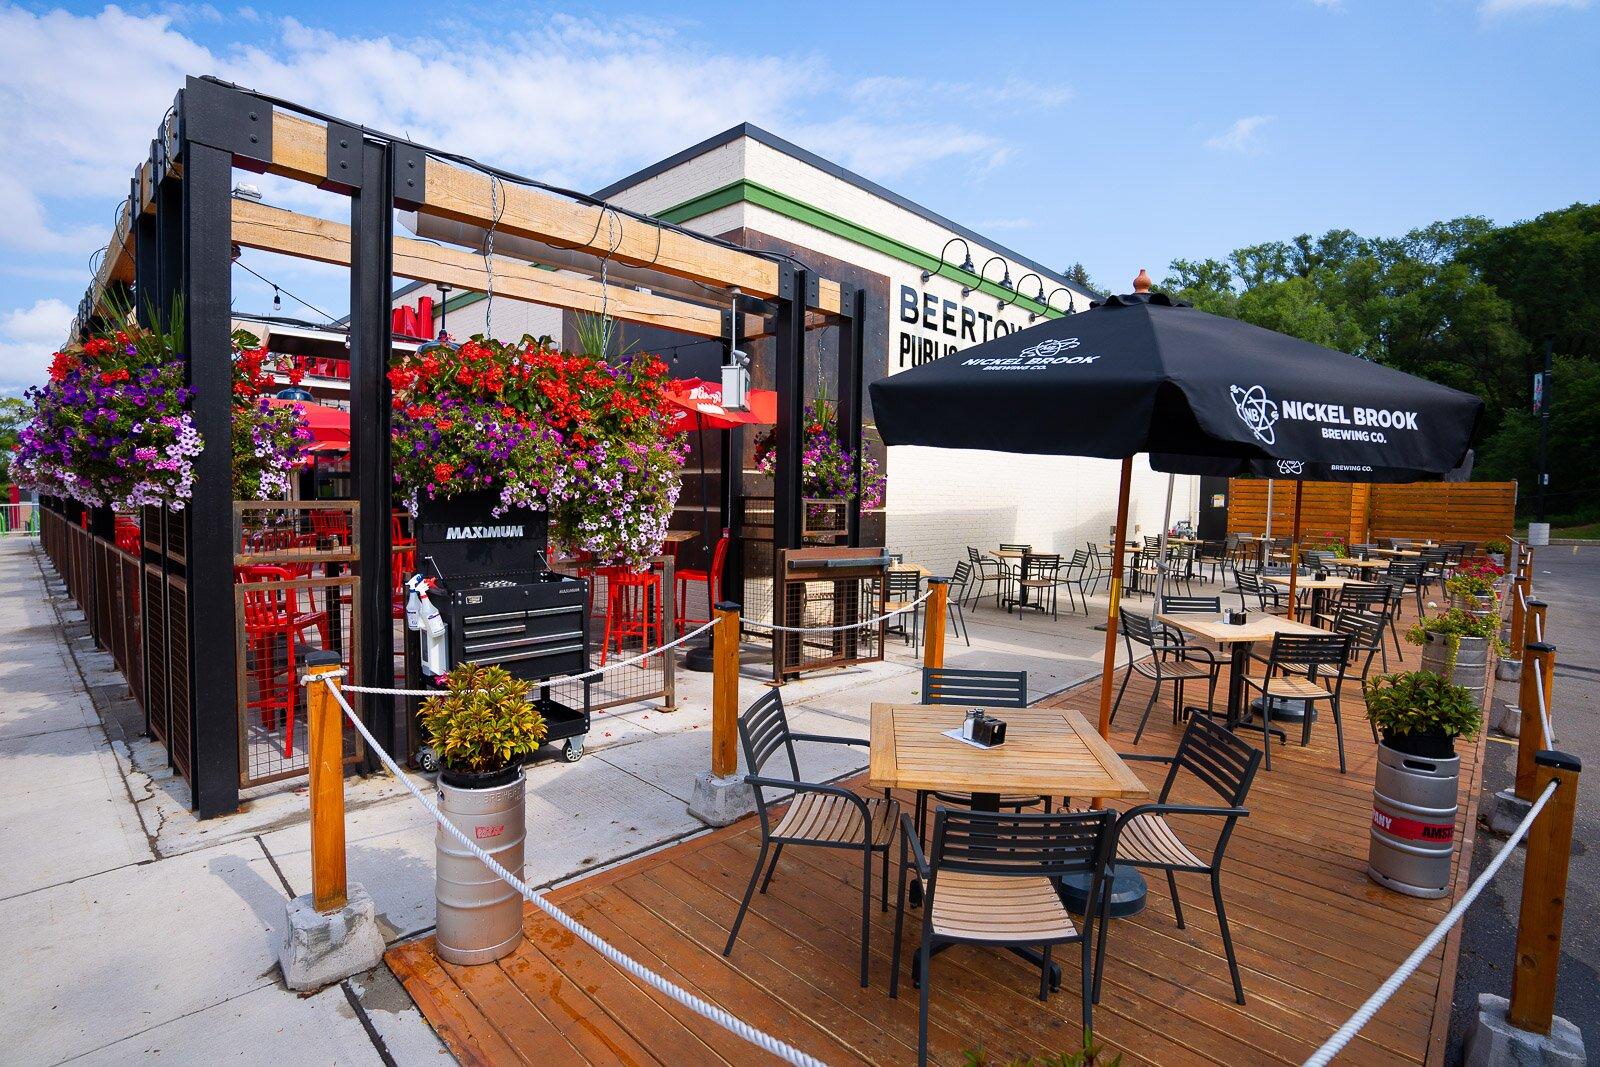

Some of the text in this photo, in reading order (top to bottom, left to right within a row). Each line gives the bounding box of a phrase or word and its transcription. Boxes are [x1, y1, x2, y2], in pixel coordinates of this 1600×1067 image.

[961, 355, 1101, 366] NICKEL BROOK
[1282, 400, 1418, 430] NICKEL BROOK
[1321, 428, 1387, 444] BREWING CO.
[446, 525, 524, 540] MAXIMUM
